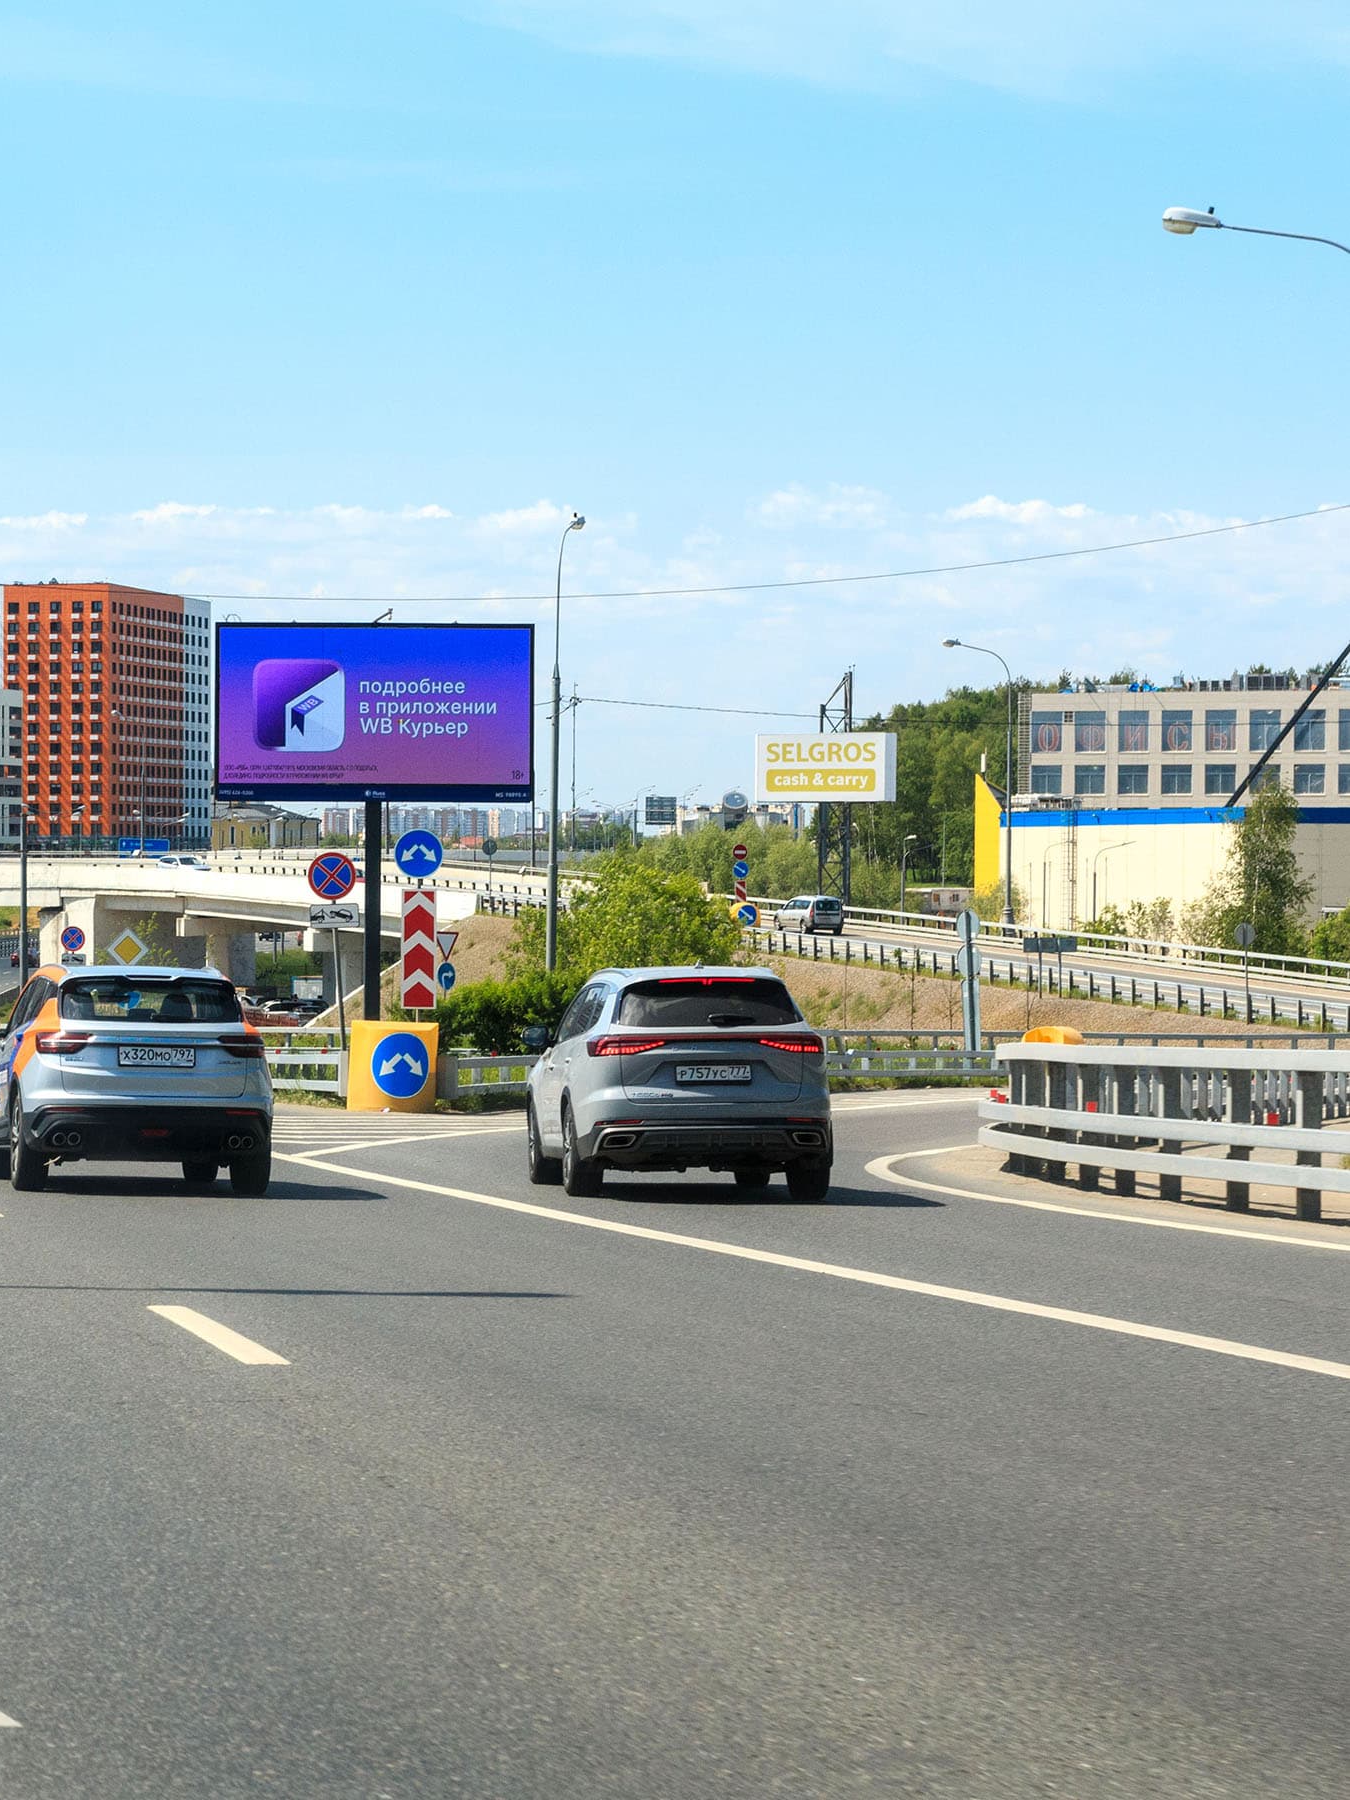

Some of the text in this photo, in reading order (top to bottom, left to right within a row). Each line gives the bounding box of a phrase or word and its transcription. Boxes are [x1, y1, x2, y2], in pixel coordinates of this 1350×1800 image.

[359, 678, 466, 698] подробнее
[359, 701, 497, 717] в приложении
[360, 717, 469, 738] WB Курьер
[766, 742, 876, 763] SELGROS
[774, 773, 869, 789] cash & carry
[123, 1048, 191, 1062] Х320МО 797
[680, 1066, 747, 1079] Р757УС 777
